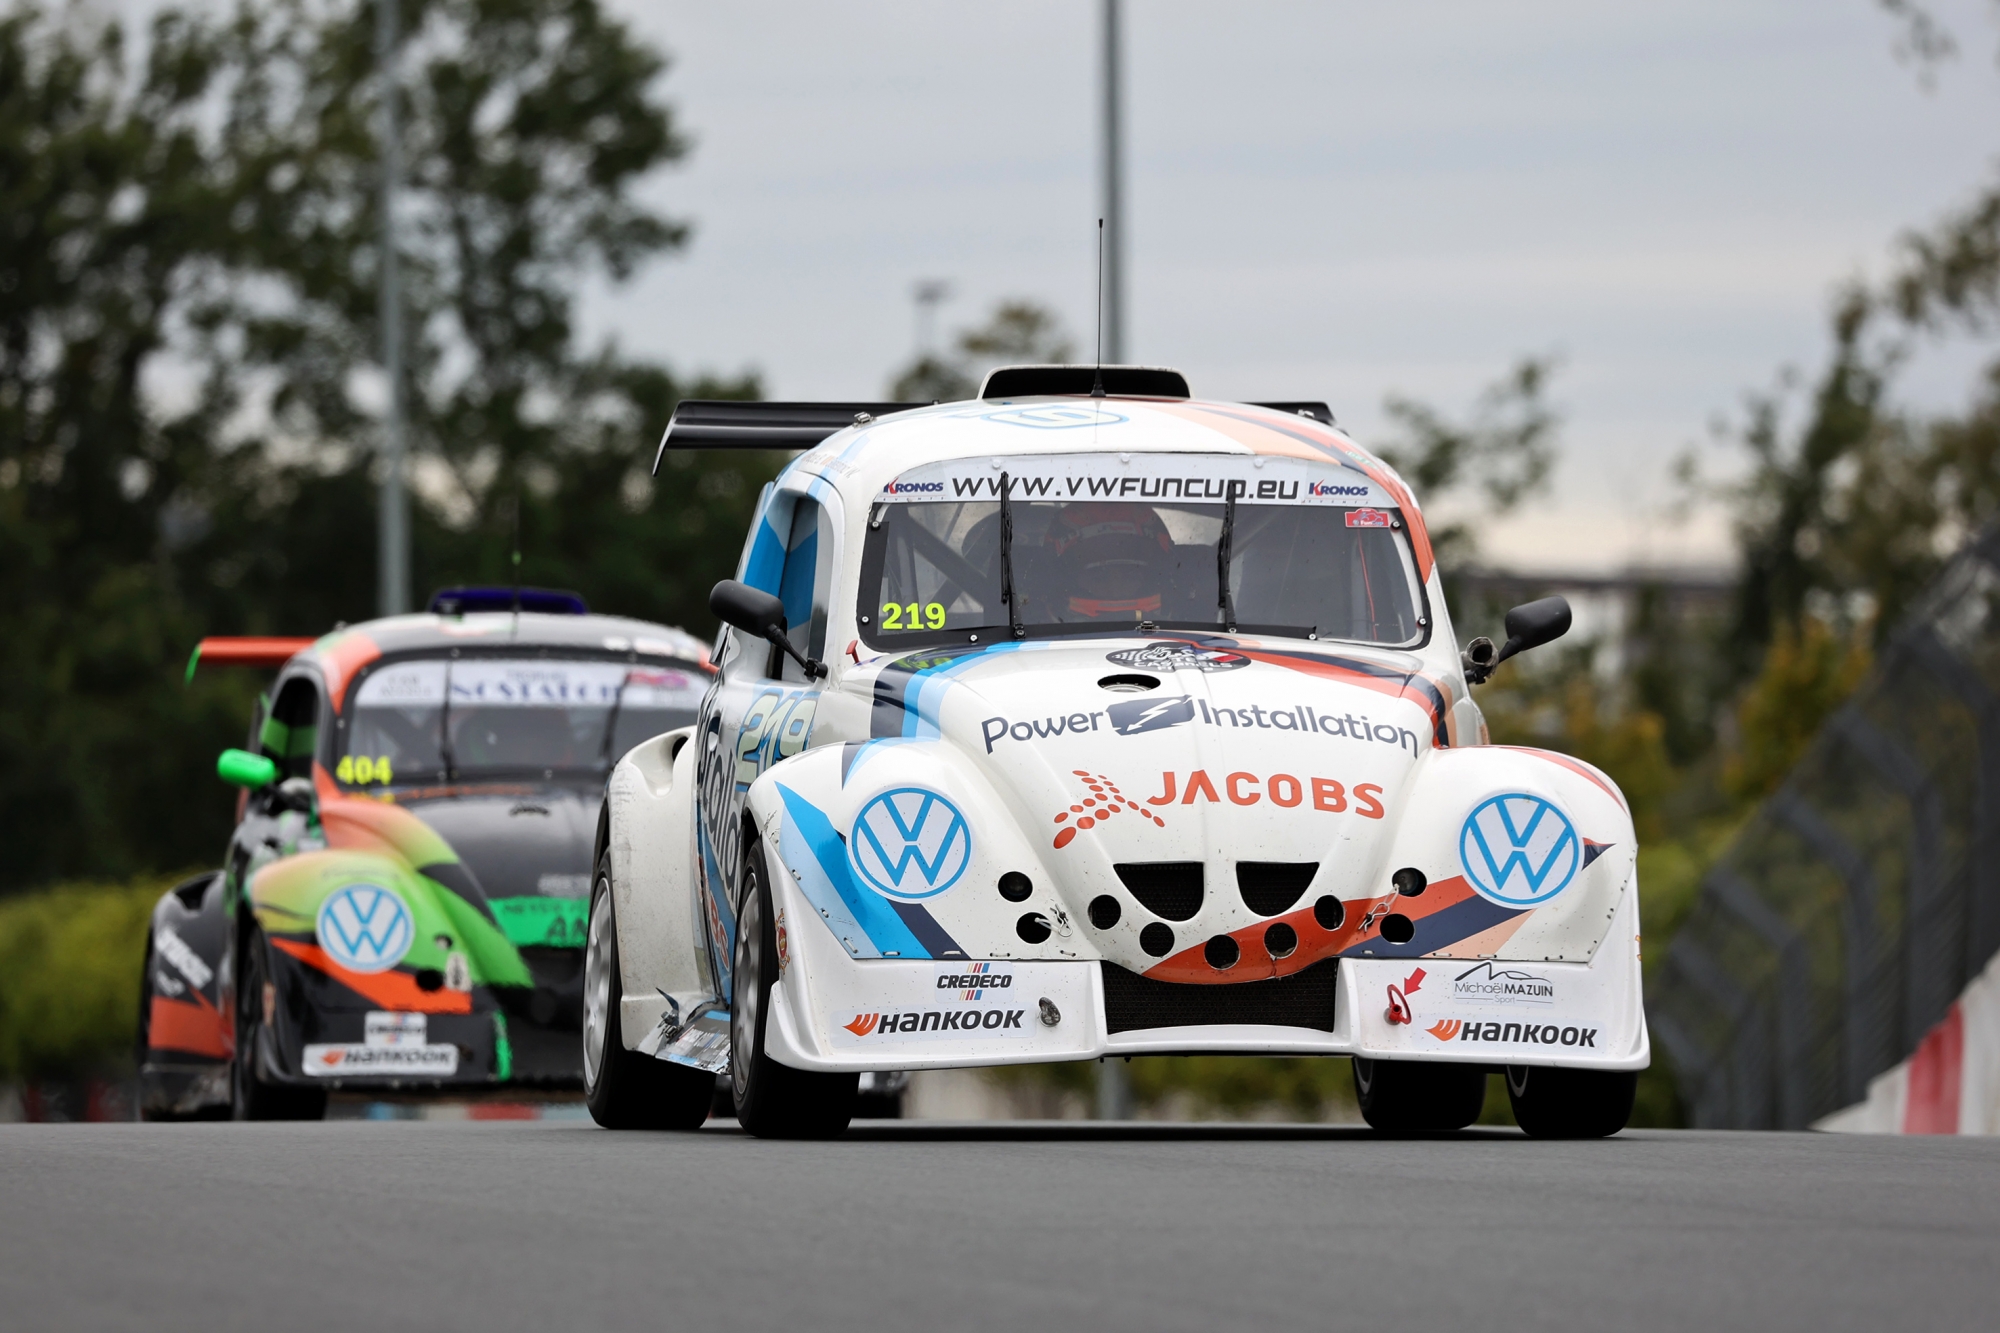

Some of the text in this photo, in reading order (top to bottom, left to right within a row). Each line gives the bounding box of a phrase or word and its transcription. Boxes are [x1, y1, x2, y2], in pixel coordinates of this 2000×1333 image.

[883, 477, 944, 495] KRONOS
[1308, 479, 1369, 497] KRONOS
[882, 602, 946, 629] 219
[736, 691, 819, 787] 219
[981, 699, 1419, 759] Power Installation
[336, 756, 393, 785] 404
[1146, 769, 1385, 820] JACOBS
[936, 974, 1013, 989] CREDECO
[878, 1009, 1026, 1035] HANKOOK
[1460, 1022, 1598, 1048] HANKOOK
